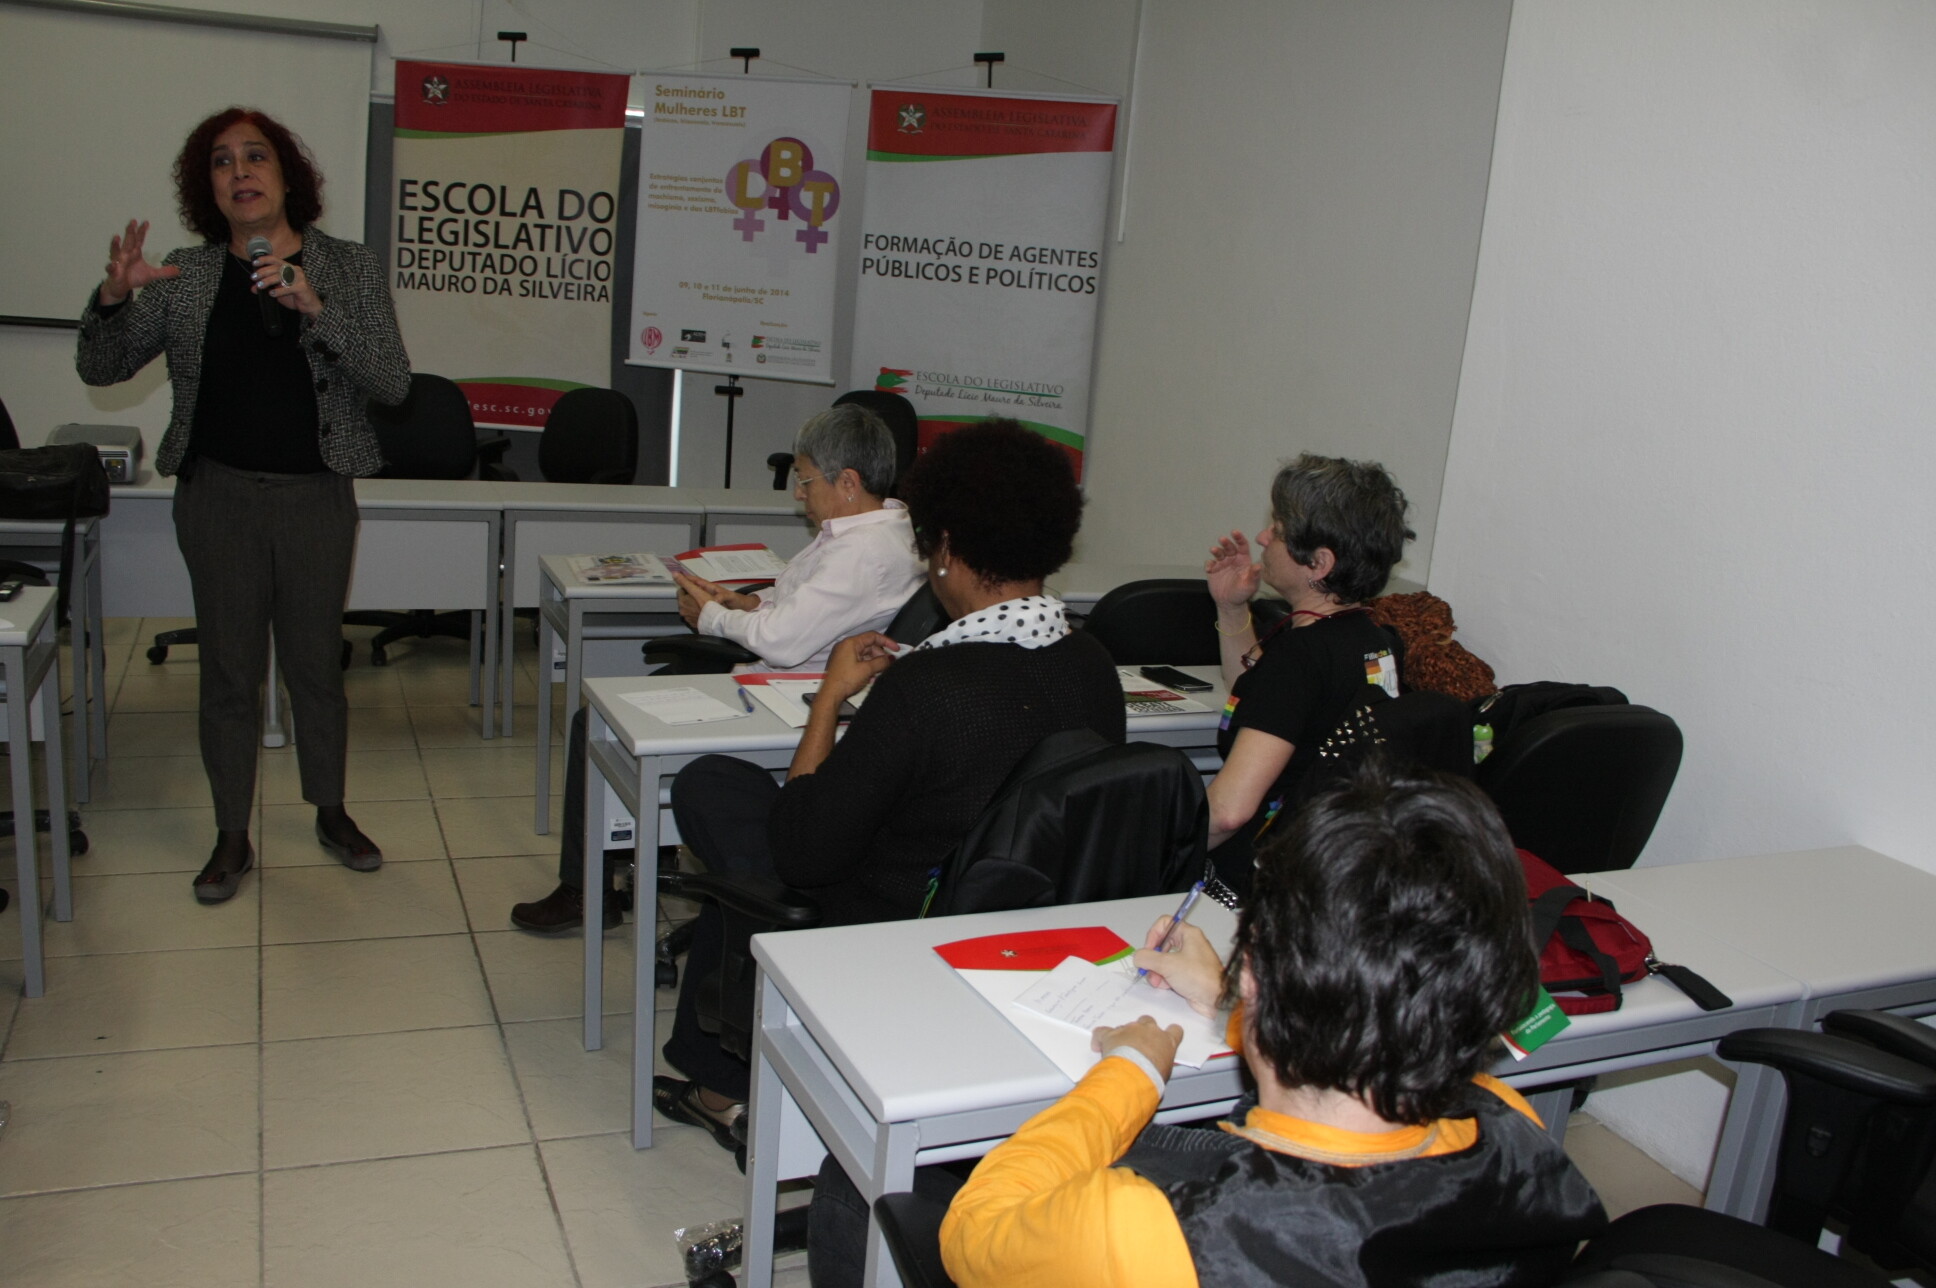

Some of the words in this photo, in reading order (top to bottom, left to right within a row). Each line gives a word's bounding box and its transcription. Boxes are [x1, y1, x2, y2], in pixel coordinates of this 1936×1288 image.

[655, 85, 726, 100] Seminário
[654, 102, 718, 118] Mulheres
[722, 105, 747, 119] LBT
[399, 178, 545, 220] ESCOLA
[558, 189, 615, 224] DO
[397, 215, 613, 257] LEGISLATIVO
[863, 233, 973, 260] FORMAÇÃO
[978, 242, 1004, 260] DE
[1008, 245, 1099, 269] AGENTES
[396, 247, 538, 277] DEPUTADO
[546, 253, 612, 282] LÍCIO
[861, 255, 962, 283] PÚBLICOS
[968, 266, 980, 285] E
[986, 267, 1097, 295] POLÍTICOS
[396, 271, 477, 294] MAURO
[483, 277, 513, 296] DA
[519, 279, 610, 303] SILVEIRA
[693, 282, 702, 290] 10
[711, 283, 720, 291] 11
[722, 284, 732, 292] de
[734, 285, 756, 295] junho
[757, 287, 768, 296] de
[770, 288, 790, 297] 2014
[914, 384, 955, 400] Deputado
[1027, 396, 1063, 409] Silveira
[916, 371, 960, 385] ESCOLA
[964, 375, 983, 387] DO
[987, 378, 1064, 395] LEGISLATIVO
